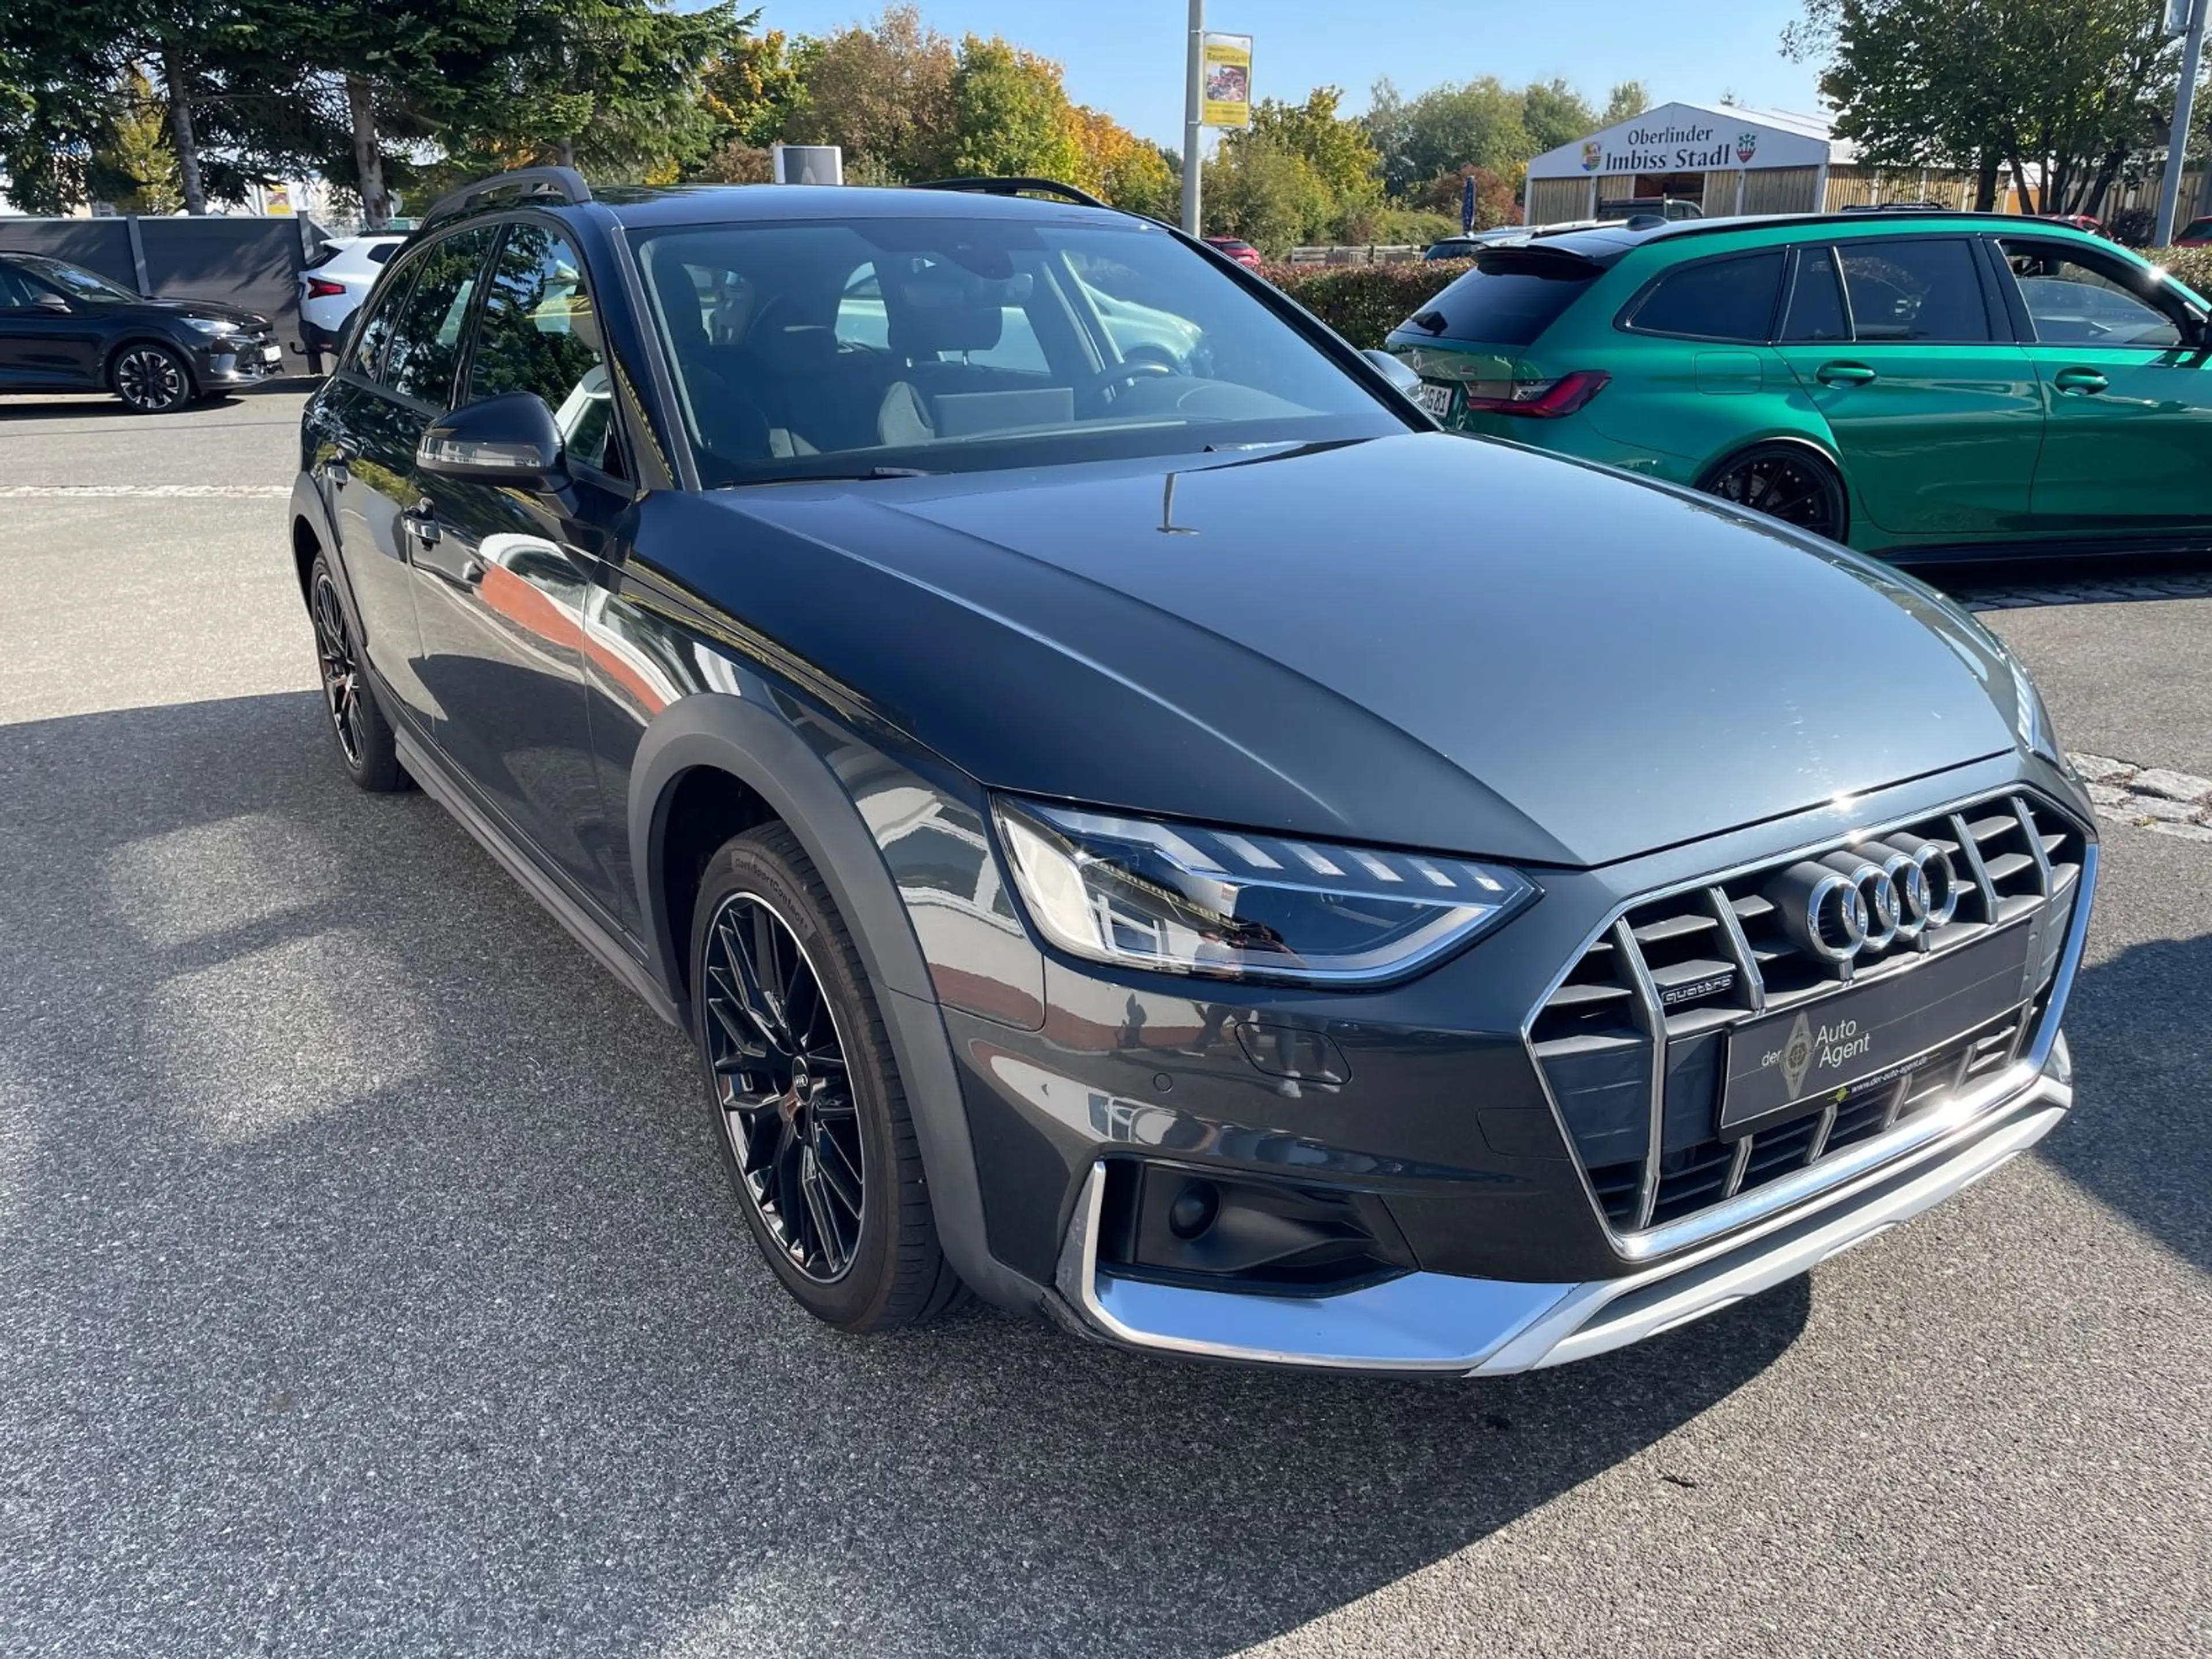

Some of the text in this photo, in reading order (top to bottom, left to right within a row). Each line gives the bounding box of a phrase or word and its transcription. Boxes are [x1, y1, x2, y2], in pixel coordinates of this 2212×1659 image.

[1628, 124, 1714, 145] Oberlinder
[1605, 143, 1730, 171] Imbiss Stadl
[1666, 978, 1732, 1003] quattro
[1815, 1018, 1857, 1048] Auto
[1762, 1033, 1870, 1069] der Agent
